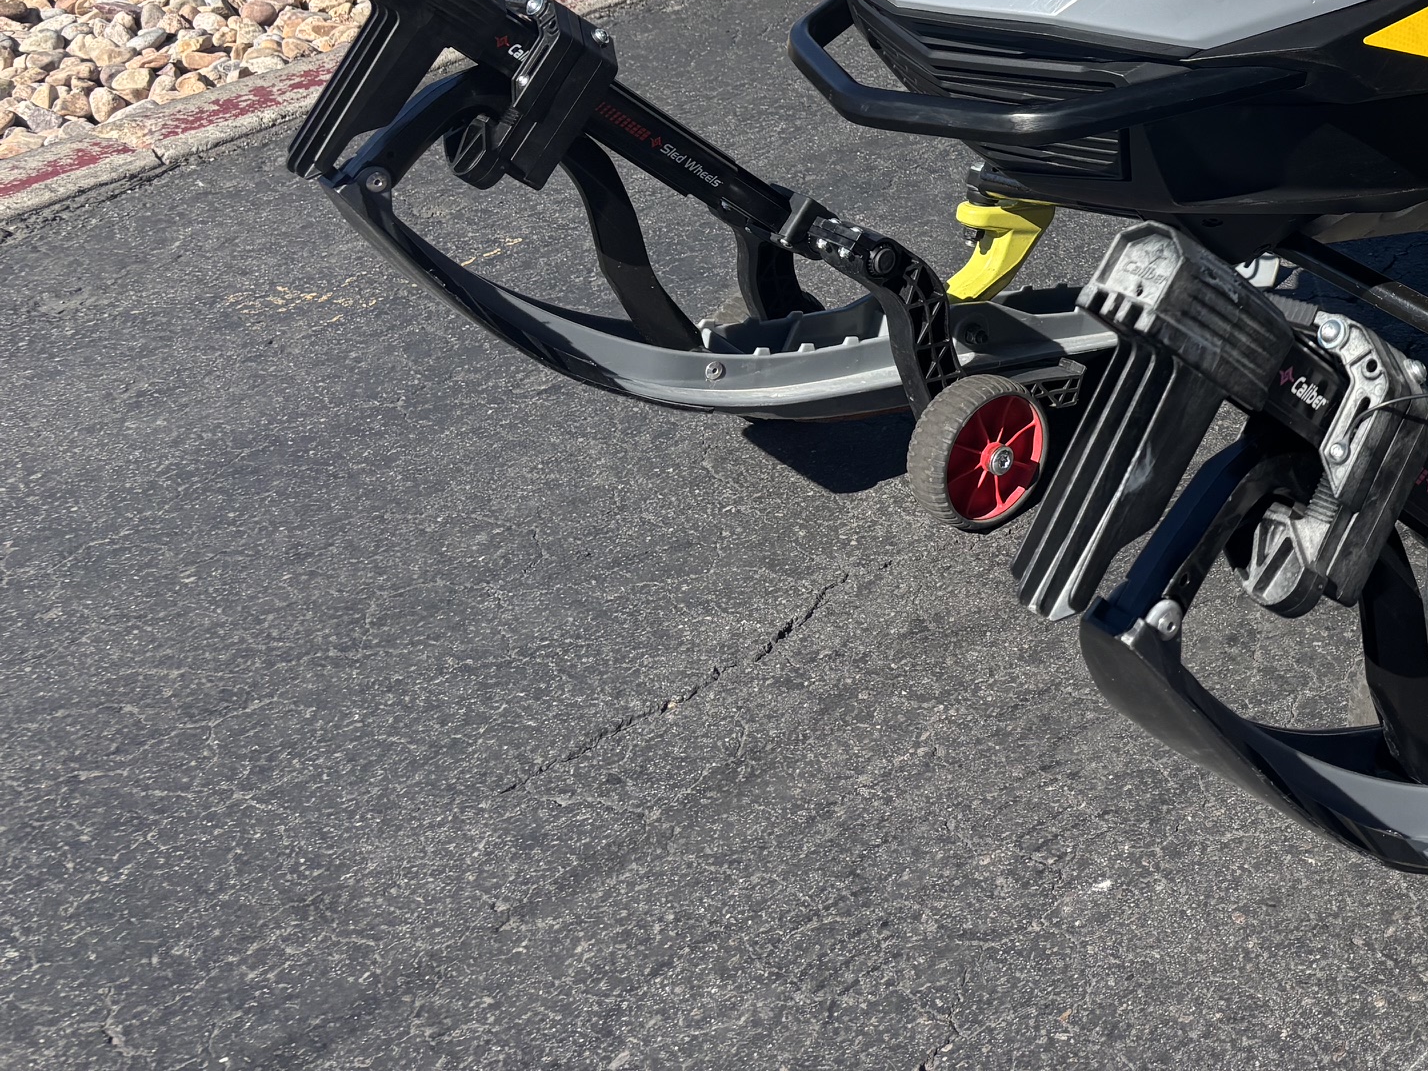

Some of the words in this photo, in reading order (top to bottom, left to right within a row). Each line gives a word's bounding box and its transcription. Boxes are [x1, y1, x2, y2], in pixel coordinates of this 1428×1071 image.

[659, 142, 687, 165] Sled
[684, 157, 722, 189] Wheels
[1290, 376, 1328, 411] Caliber
